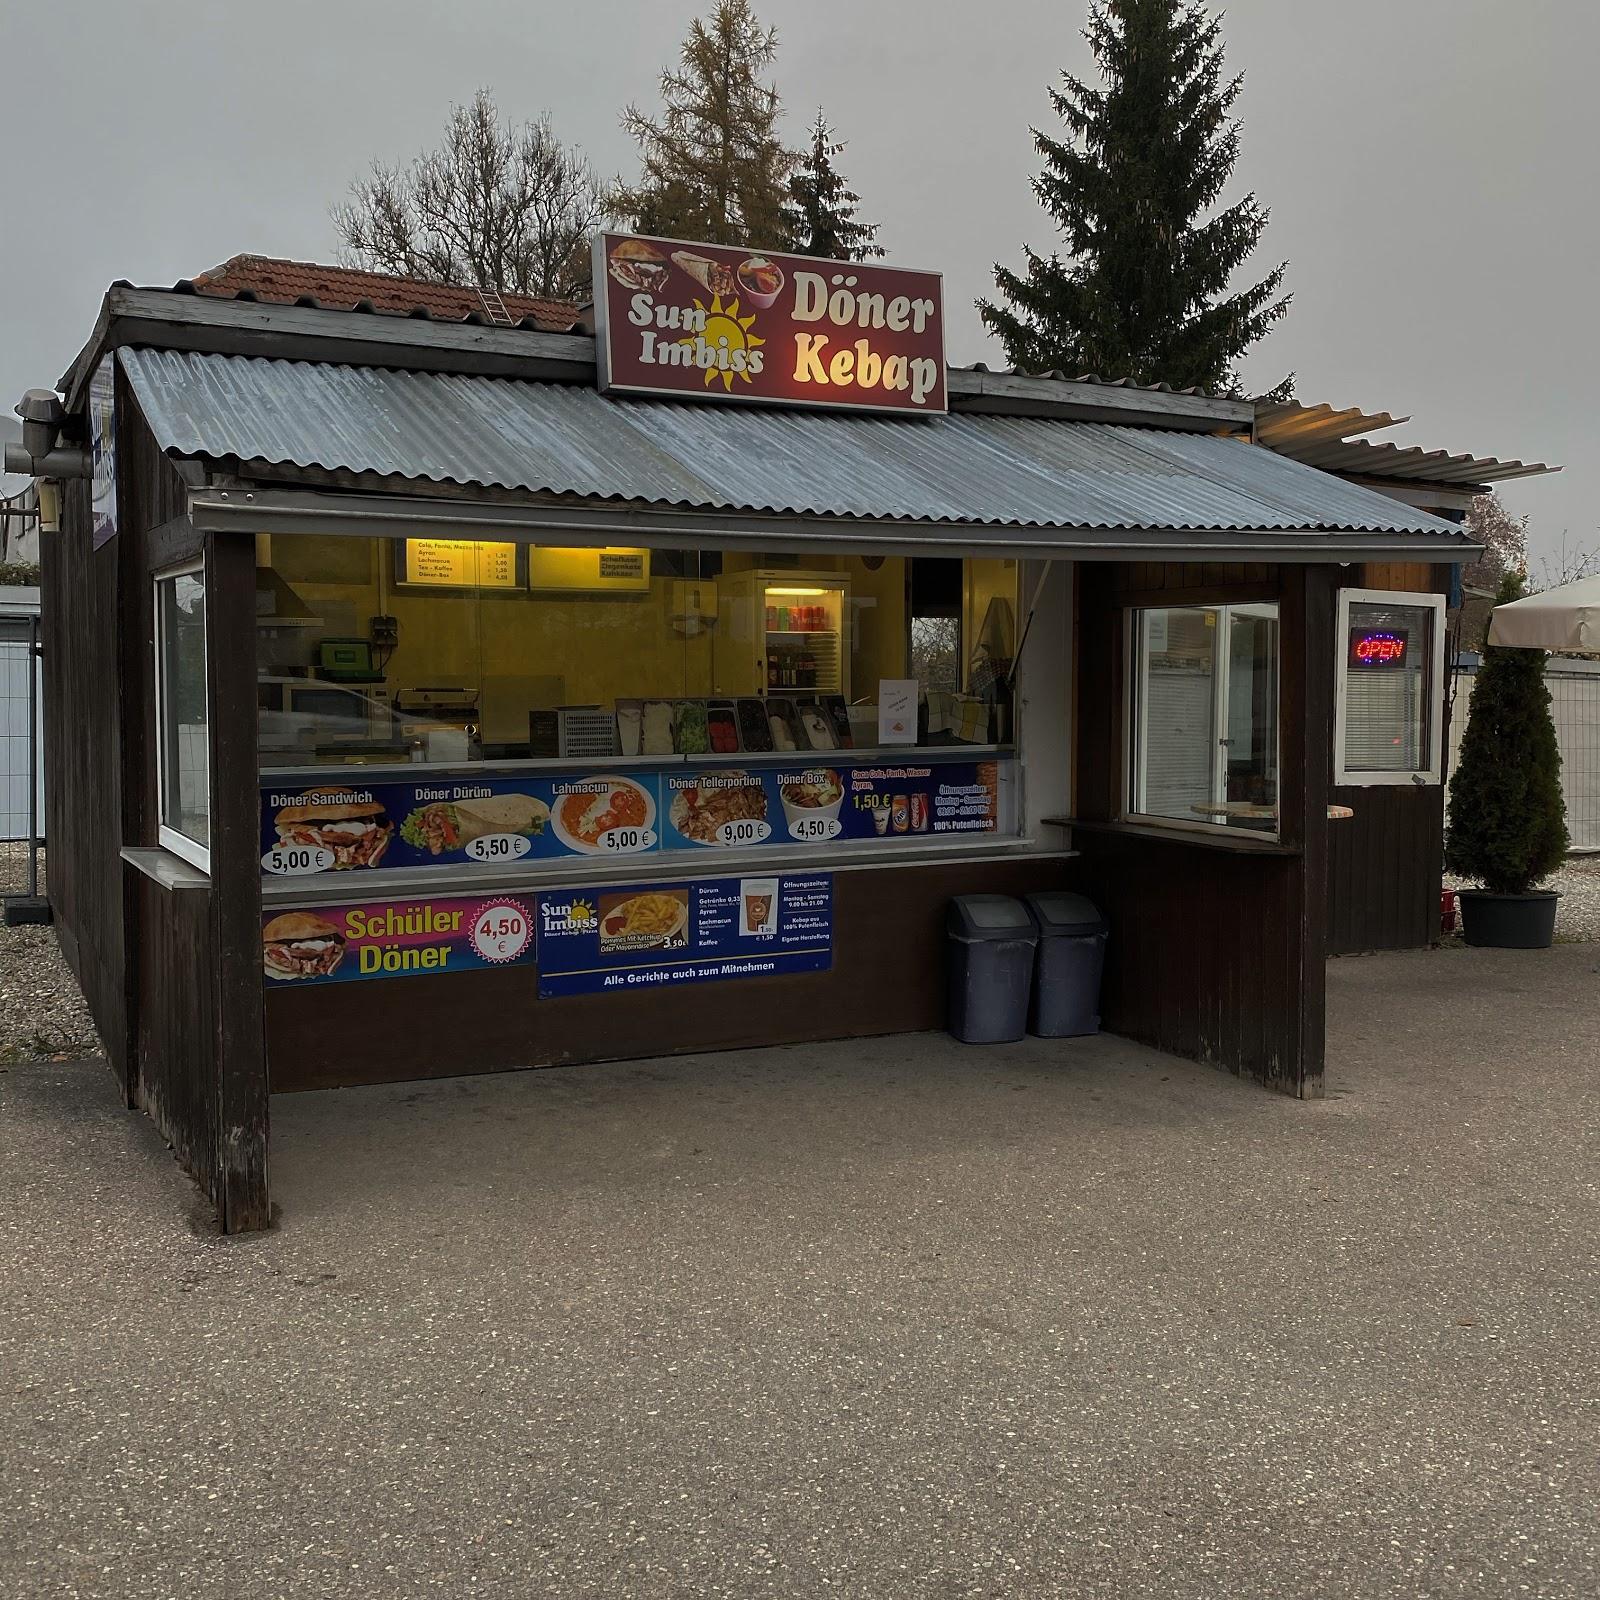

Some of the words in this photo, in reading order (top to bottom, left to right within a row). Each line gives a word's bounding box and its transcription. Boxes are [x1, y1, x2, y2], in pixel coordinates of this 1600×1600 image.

[791, 271, 934, 333] Döner
[628, 294, 707, 332] Sun
[639, 331, 764, 374] Imbiss
[792, 333, 937, 404] Kebap
[1357, 641, 1404, 658] OPEN
[777, 774, 805, 785] Döner
[807, 772, 825, 784] Box
[907, 768, 931, 777] Wasser
[552, 782, 608, 795] Lahmacun
[669, 778, 699, 790] Döner
[701, 776, 762, 788] Tellerportion
[270, 794, 308, 807] Döner
[311, 791, 373, 806] Sandwich
[415, 788, 450, 800] Döner
[453, 786, 492, 799] Dürüm
[935, 797, 960, 807] Montag
[964, 795, 992, 805] Samstag
[853, 795, 879, 810] 1,50
[883, 794, 891, 808] €
[724, 823, 753, 843] 9,00
[757, 824, 764, 838] €
[797, 821, 824, 840] 4,50
[828, 821, 835, 835] €
[933, 820, 951, 831] 100%
[952, 819, 994, 830] Putenfleisch
[475, 838, 509, 858] 5,50
[514, 838, 522, 854] €
[607, 831, 638, 851] 5,00
[642, 831, 649, 846] €
[272, 850, 310, 872] 5,00
[314, 851, 324, 867] €
[699, 897, 726, 905] Getränke
[541, 903, 572, 917] Sun
[345, 905, 464, 939] Schüler
[479, 918, 522, 939] 4,50
[544, 915, 598, 931] Imbiss
[798, 921, 829, 929] Putenfleisch
[627, 935, 637, 943] Mit
[637, 933, 662, 943] Ketchup
[800, 933, 830, 941] Herstellung
[497, 940, 506, 953] €
[600, 944, 615, 952] Oder
[615, 943, 649, 951] Mayonnaise
[359, 943, 452, 974] Döner
[604, 974, 625, 986] Alle
[627, 971, 670, 983] Gerichte
[672, 968, 696, 979] auch
[698, 968, 719, 976] zum
[721, 962, 775, 974] Mitnehmen
